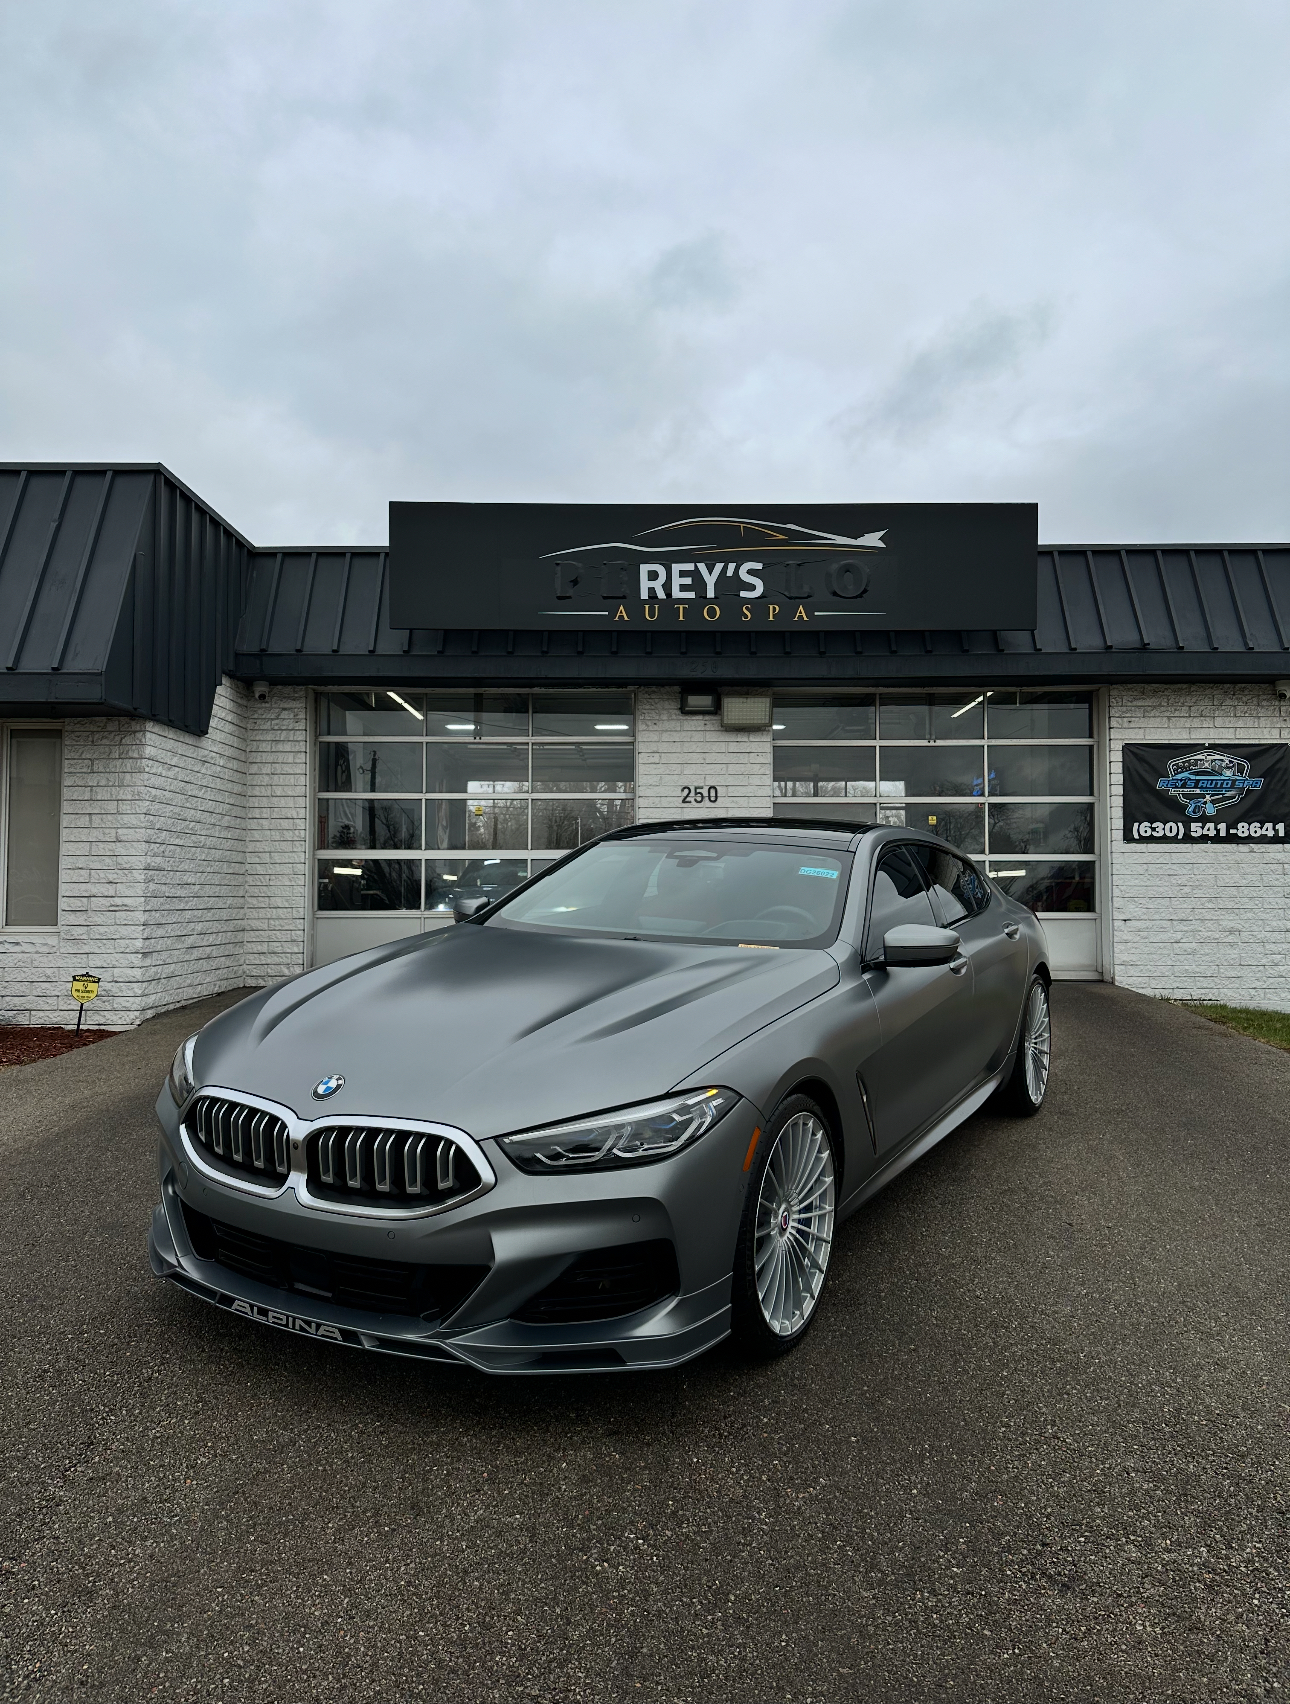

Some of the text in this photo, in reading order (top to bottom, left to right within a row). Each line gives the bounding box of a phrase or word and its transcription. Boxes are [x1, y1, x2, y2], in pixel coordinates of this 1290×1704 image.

[640, 562, 764, 600] REY'S
[613, 604, 811, 622] AUTO SPA
[1159, 778, 1262, 788] REY'S AUTO SPA
[681, 786, 718, 803] 250
[1132, 821, 1286, 840] (630) 541-8641
[231, 1299, 343, 1342] ALPINA
